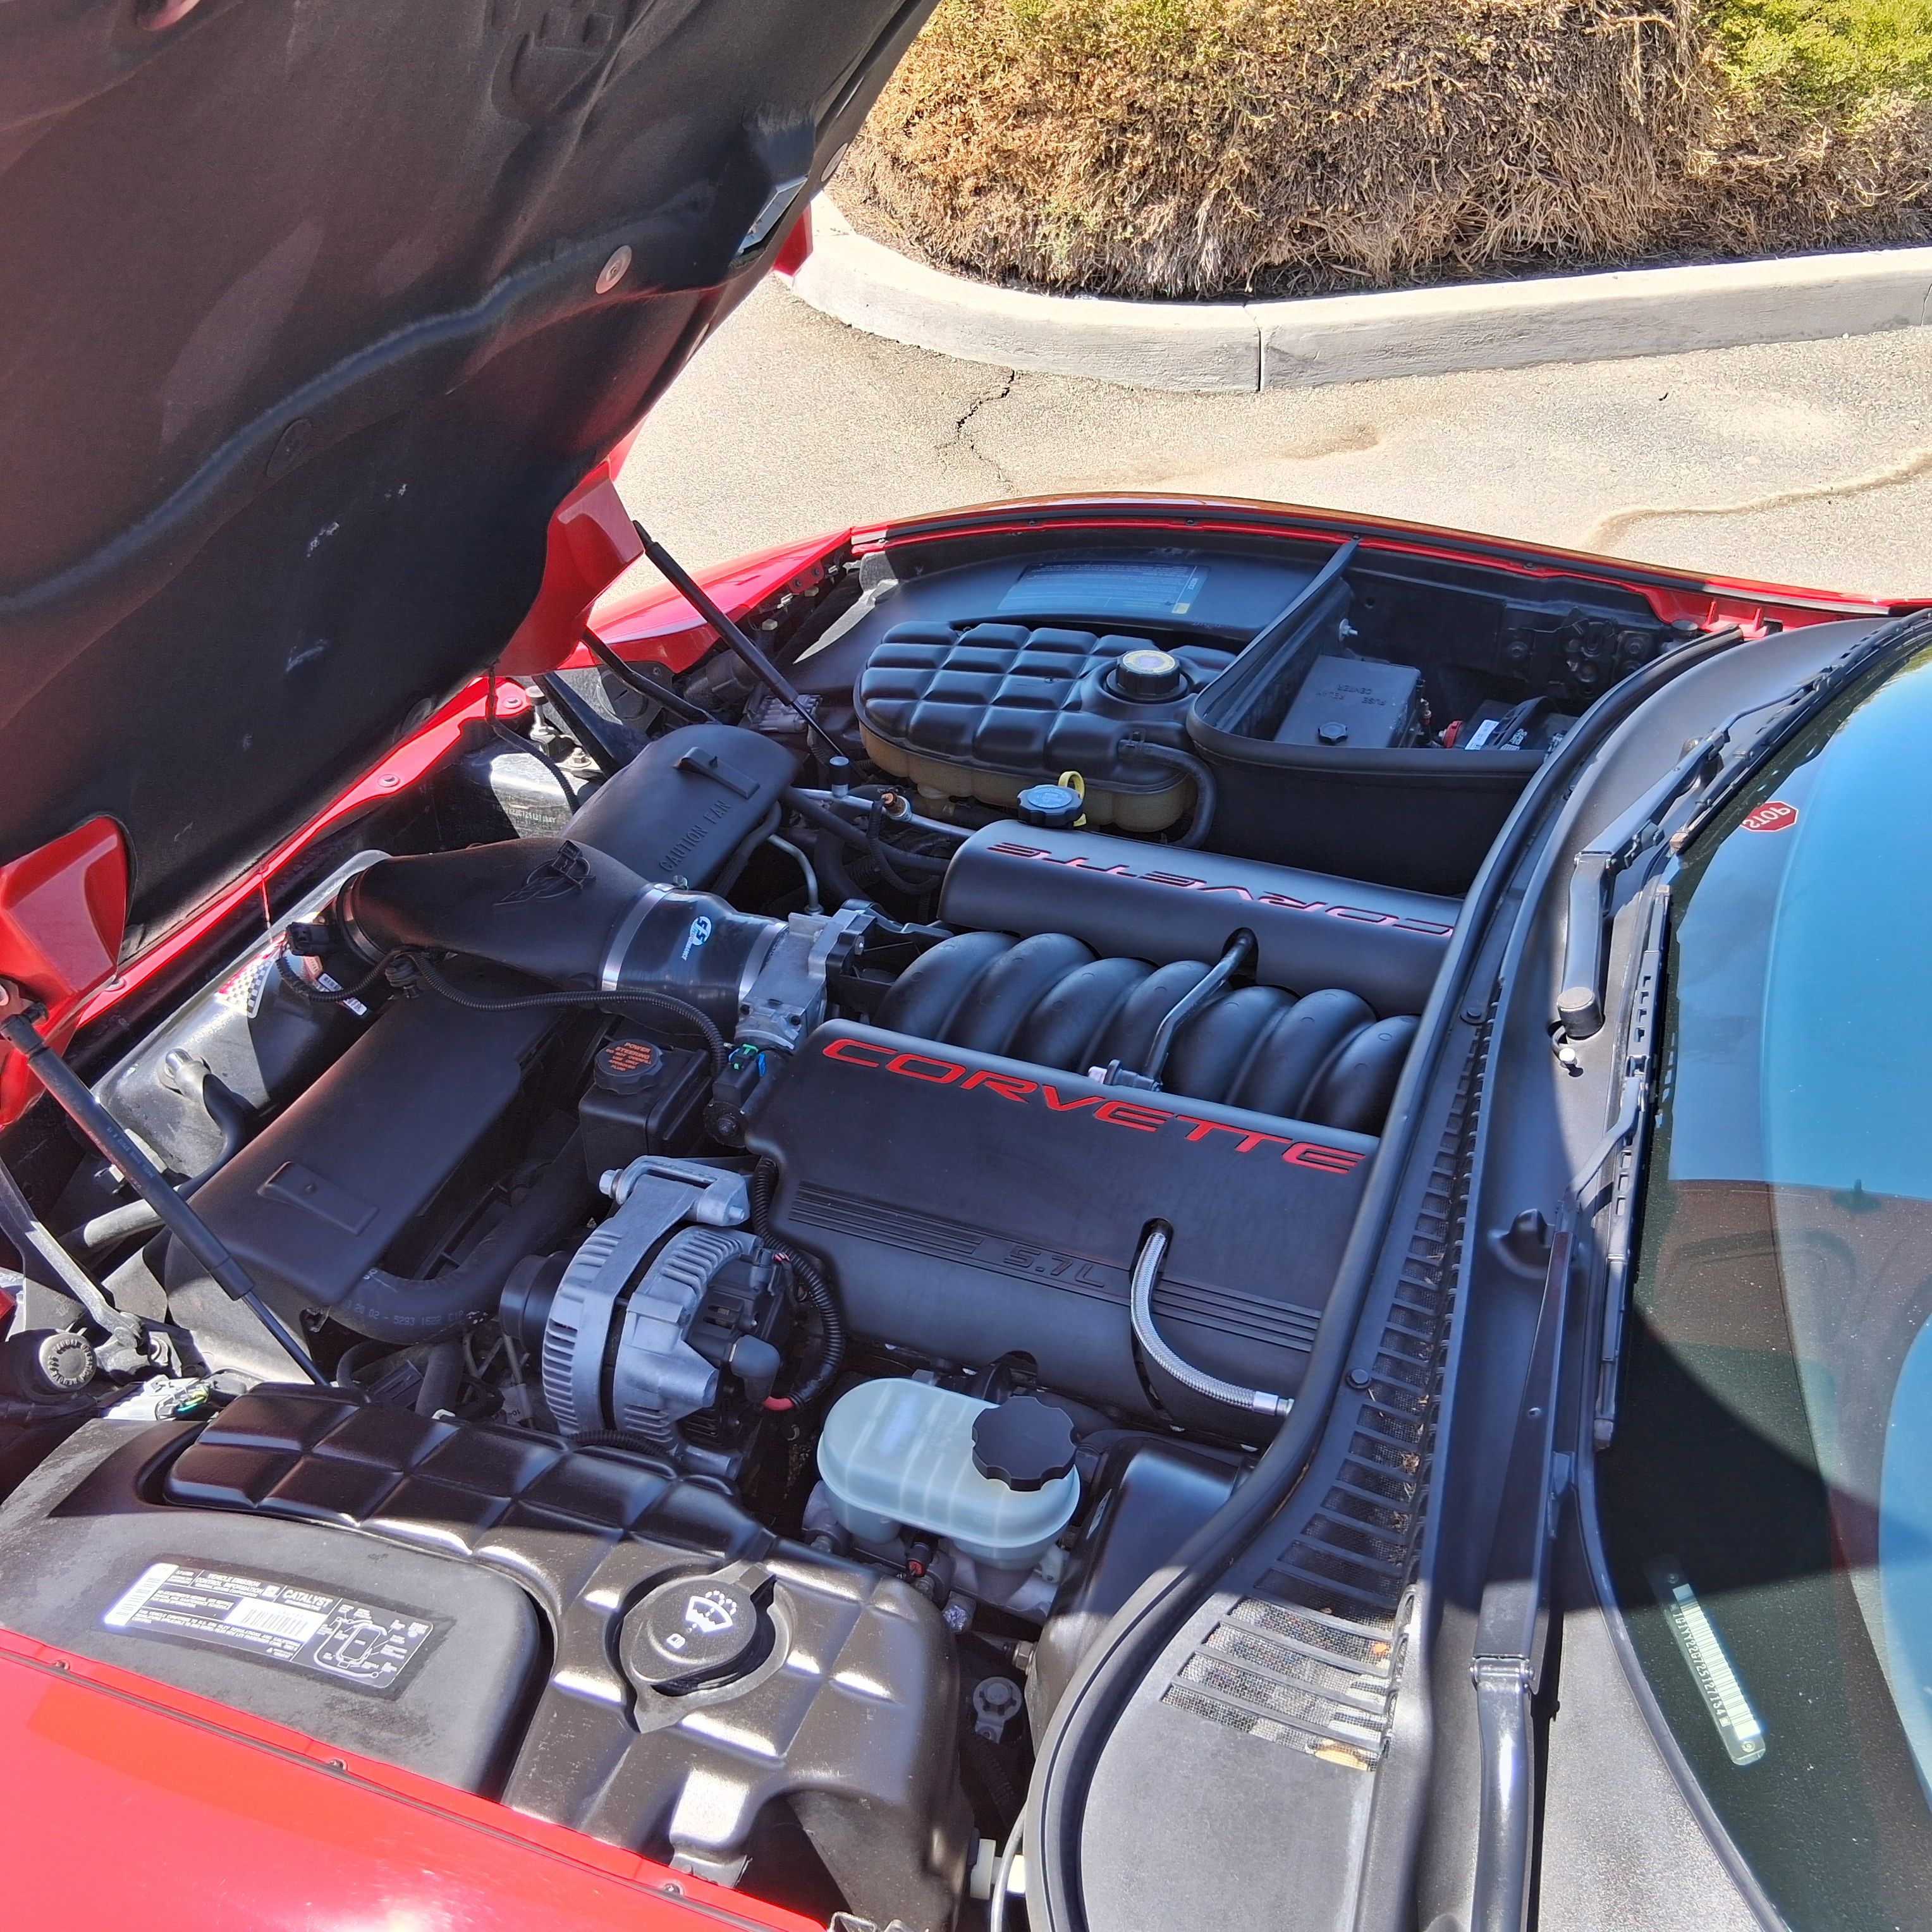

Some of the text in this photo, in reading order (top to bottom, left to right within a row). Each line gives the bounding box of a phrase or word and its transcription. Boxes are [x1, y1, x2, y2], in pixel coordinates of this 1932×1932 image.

[1337, 684, 1373, 695] CENTER
[1362, 697, 1386, 706] FUSE
[659, 799, 732, 872] CAUTION FAN
[986, 841, 1455, 938] CORVETTE
[614, 1046, 651, 1060] STEERING
[623, 1042, 651, 1053] POWER
[822, 1037, 1366, 1175] CORVETTE
[1003, 1245, 1105, 1288] 5.7L
[195, 1577, 223, 1587] CONTROL
[223, 1582, 264, 1594] INFORMATION
[283, 1588, 334, 1608] CATALYST
[1672, 1611, 1725, 1716] 1G1YY22G725127134
